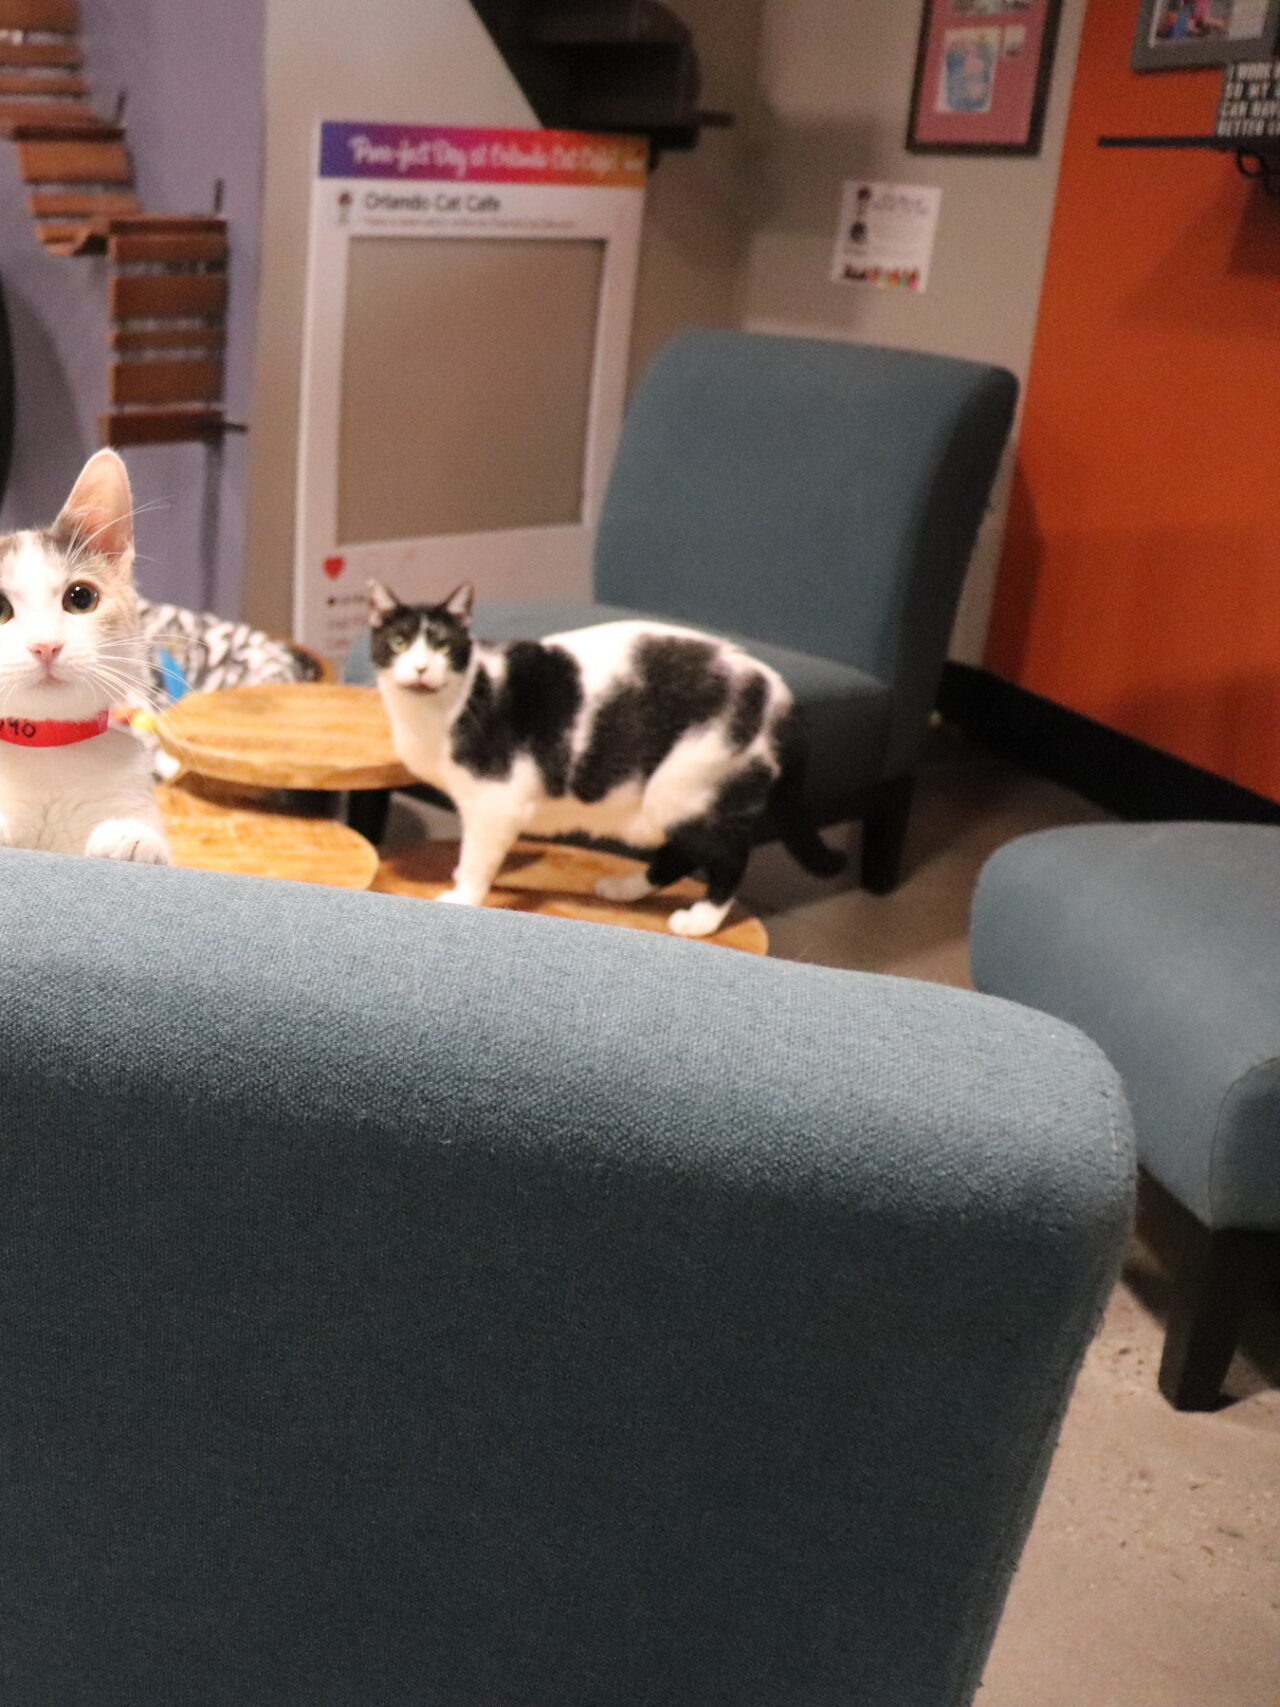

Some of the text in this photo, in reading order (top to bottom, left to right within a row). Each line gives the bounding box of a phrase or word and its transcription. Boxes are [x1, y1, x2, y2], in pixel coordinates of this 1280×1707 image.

[1239, 63, 1273, 80] WORK
[1225, 83, 1244, 98] SO
[1221, 101, 1248, 117] CAN
[1218, 119, 1265, 136] BETTER
[431, 138, 467, 177] Day
[366, 191, 500, 212] Orlando Cat Cafe
